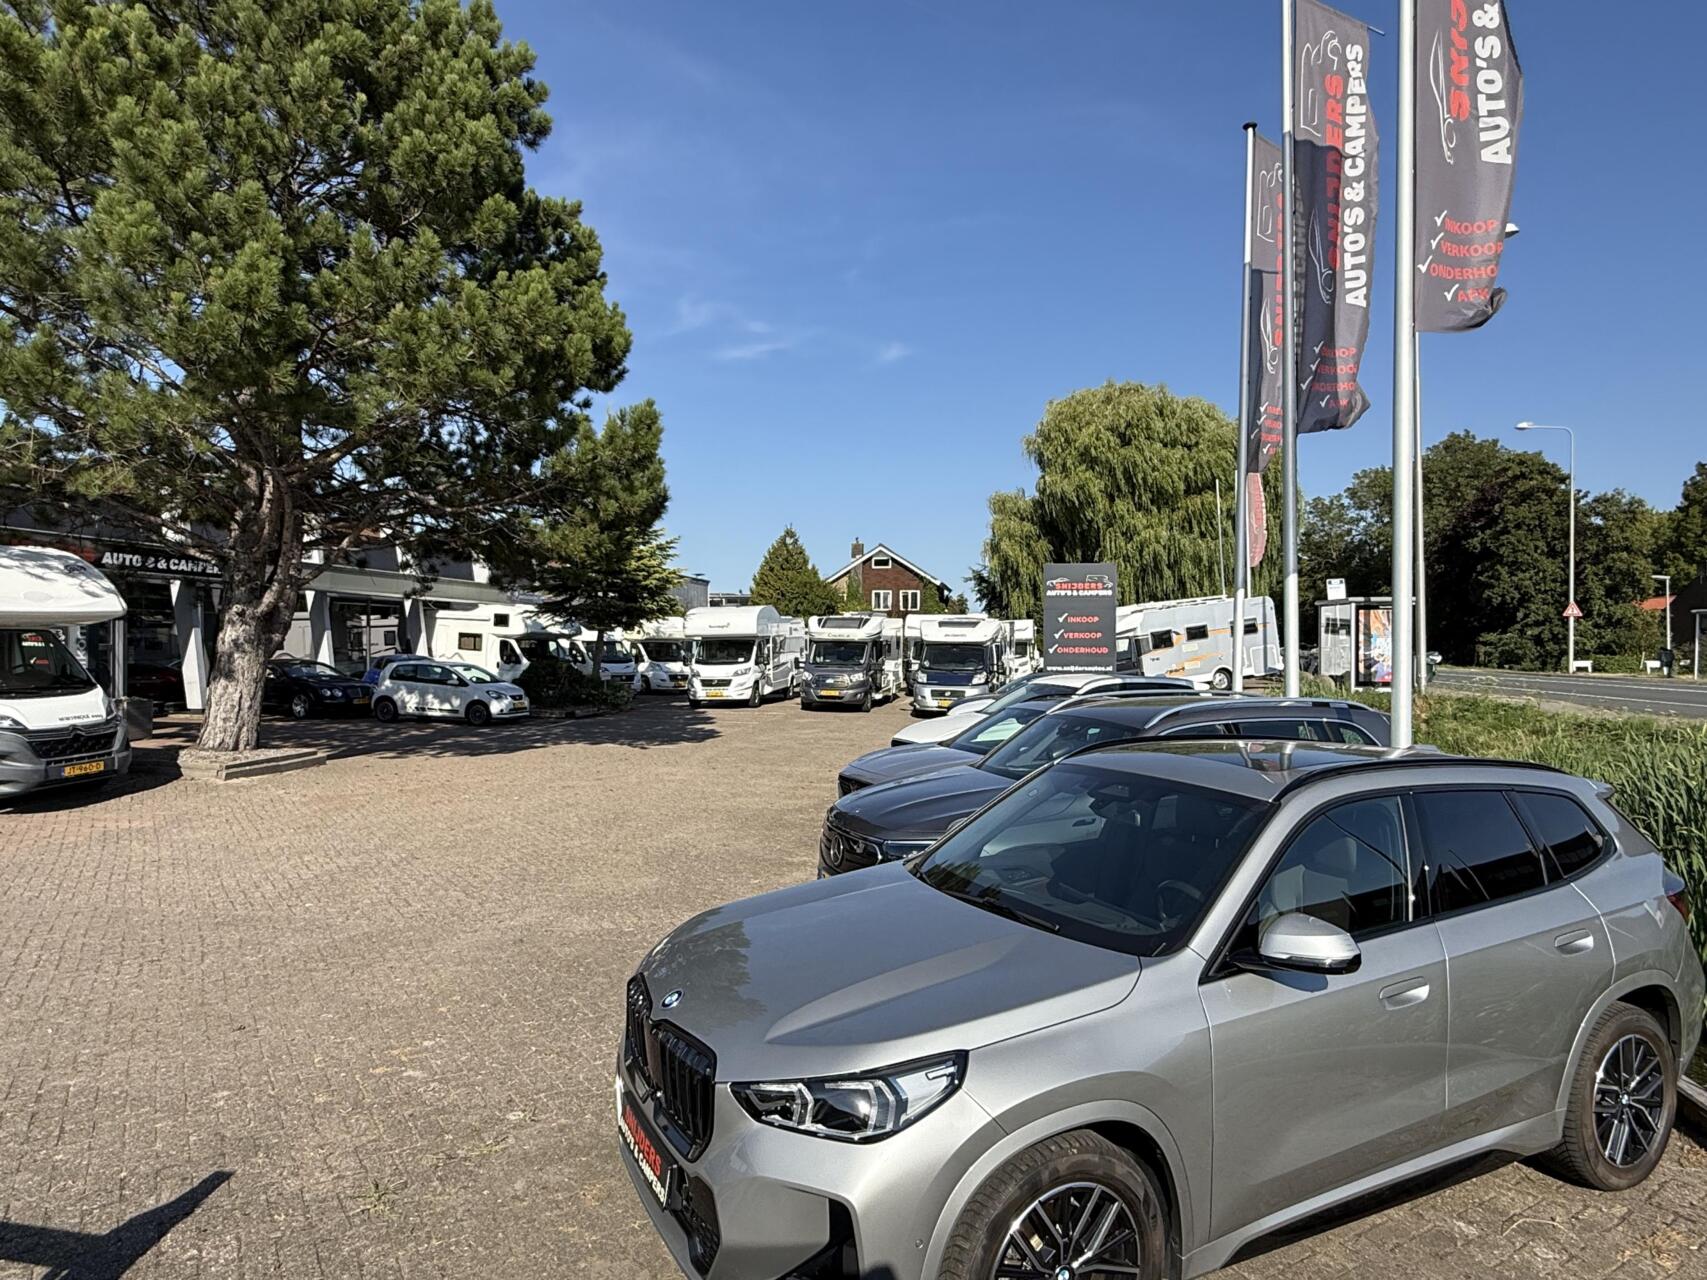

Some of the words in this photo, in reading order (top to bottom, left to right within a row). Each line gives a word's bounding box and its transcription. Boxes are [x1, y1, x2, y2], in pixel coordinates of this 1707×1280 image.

[1472, 2, 1500, 29] &
[1344, 43, 1367, 178] CAMPERS
[1474, 35, 1512, 165] AUTO'S
[1343, 180, 1365, 202] &
[1343, 206, 1367, 308] AUTO'S
[1056, 646, 1109, 654] ONDERHOUD
